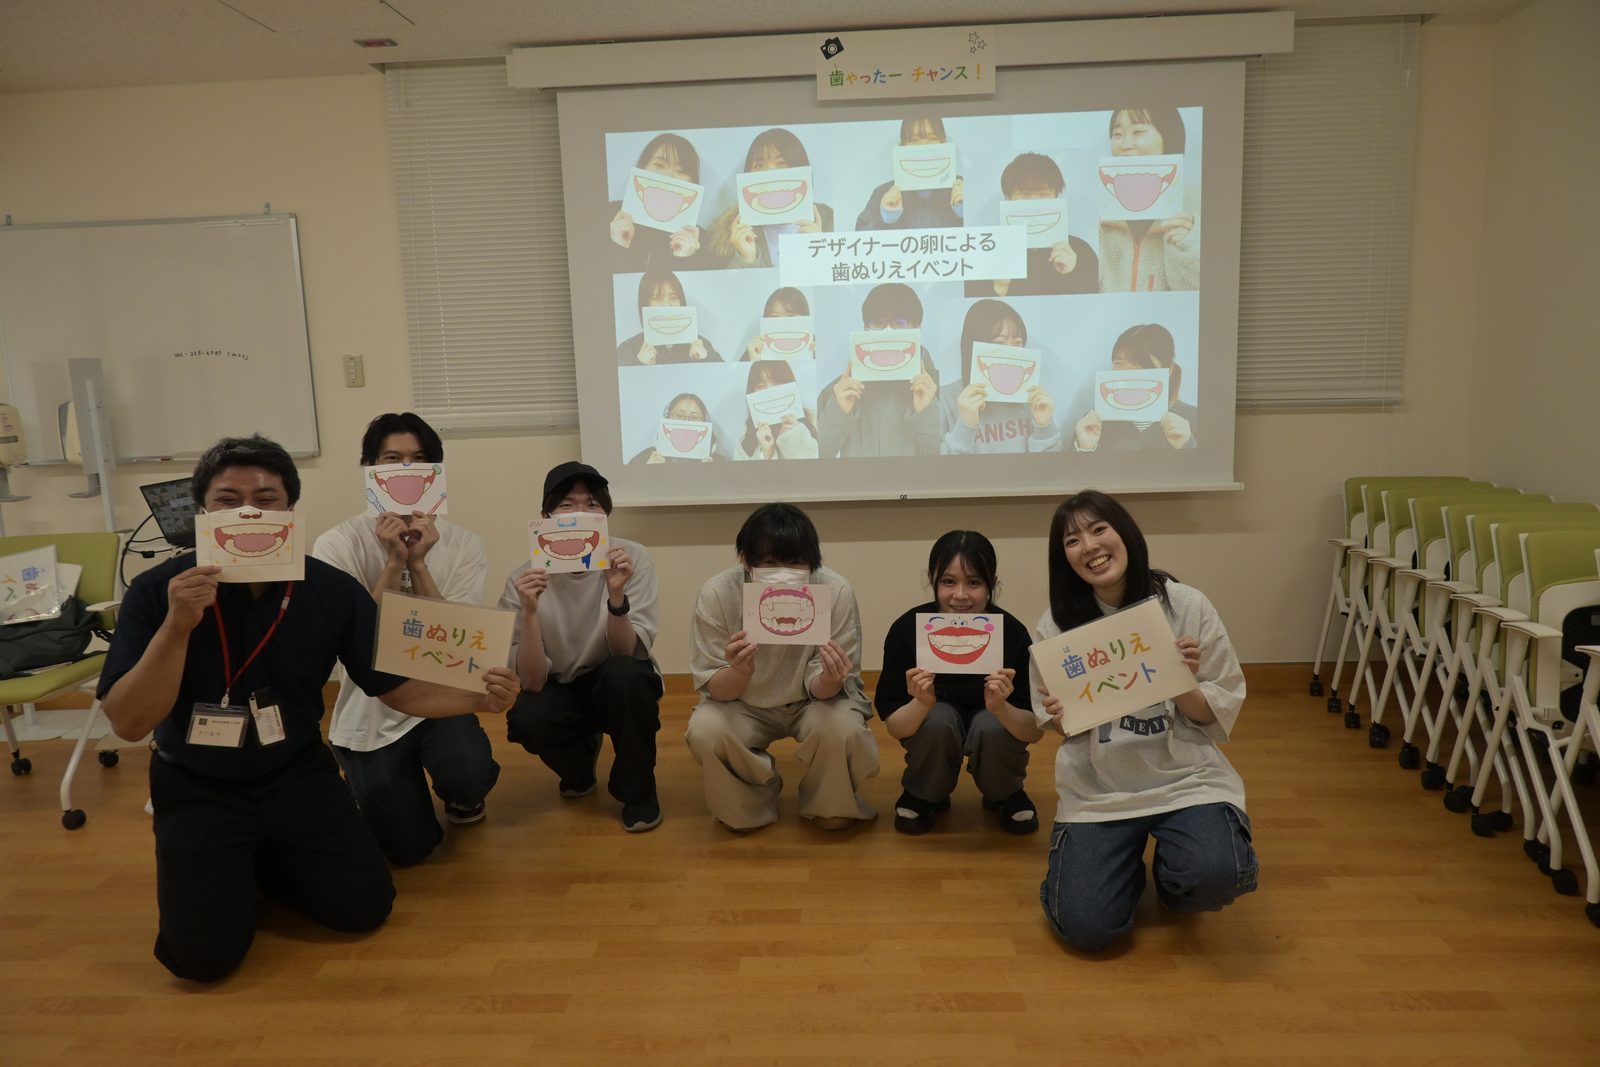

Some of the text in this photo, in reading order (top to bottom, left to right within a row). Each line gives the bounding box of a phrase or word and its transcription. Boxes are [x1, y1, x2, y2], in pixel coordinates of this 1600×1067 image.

[829, 69, 902, 87] 歯やったー
[808, 232, 996, 258] デザイナーの卵による
[831, 258, 974, 282] 歯ぬりえイベント
[402, 618, 488, 651] 歯ぬりえ
[404, 645, 480, 674] イベント
[1061, 632, 1151, 680] 歯ぬりえ
[1079, 662, 1157, 703] イベント
[1123, 717, 1161, 733] KEY
